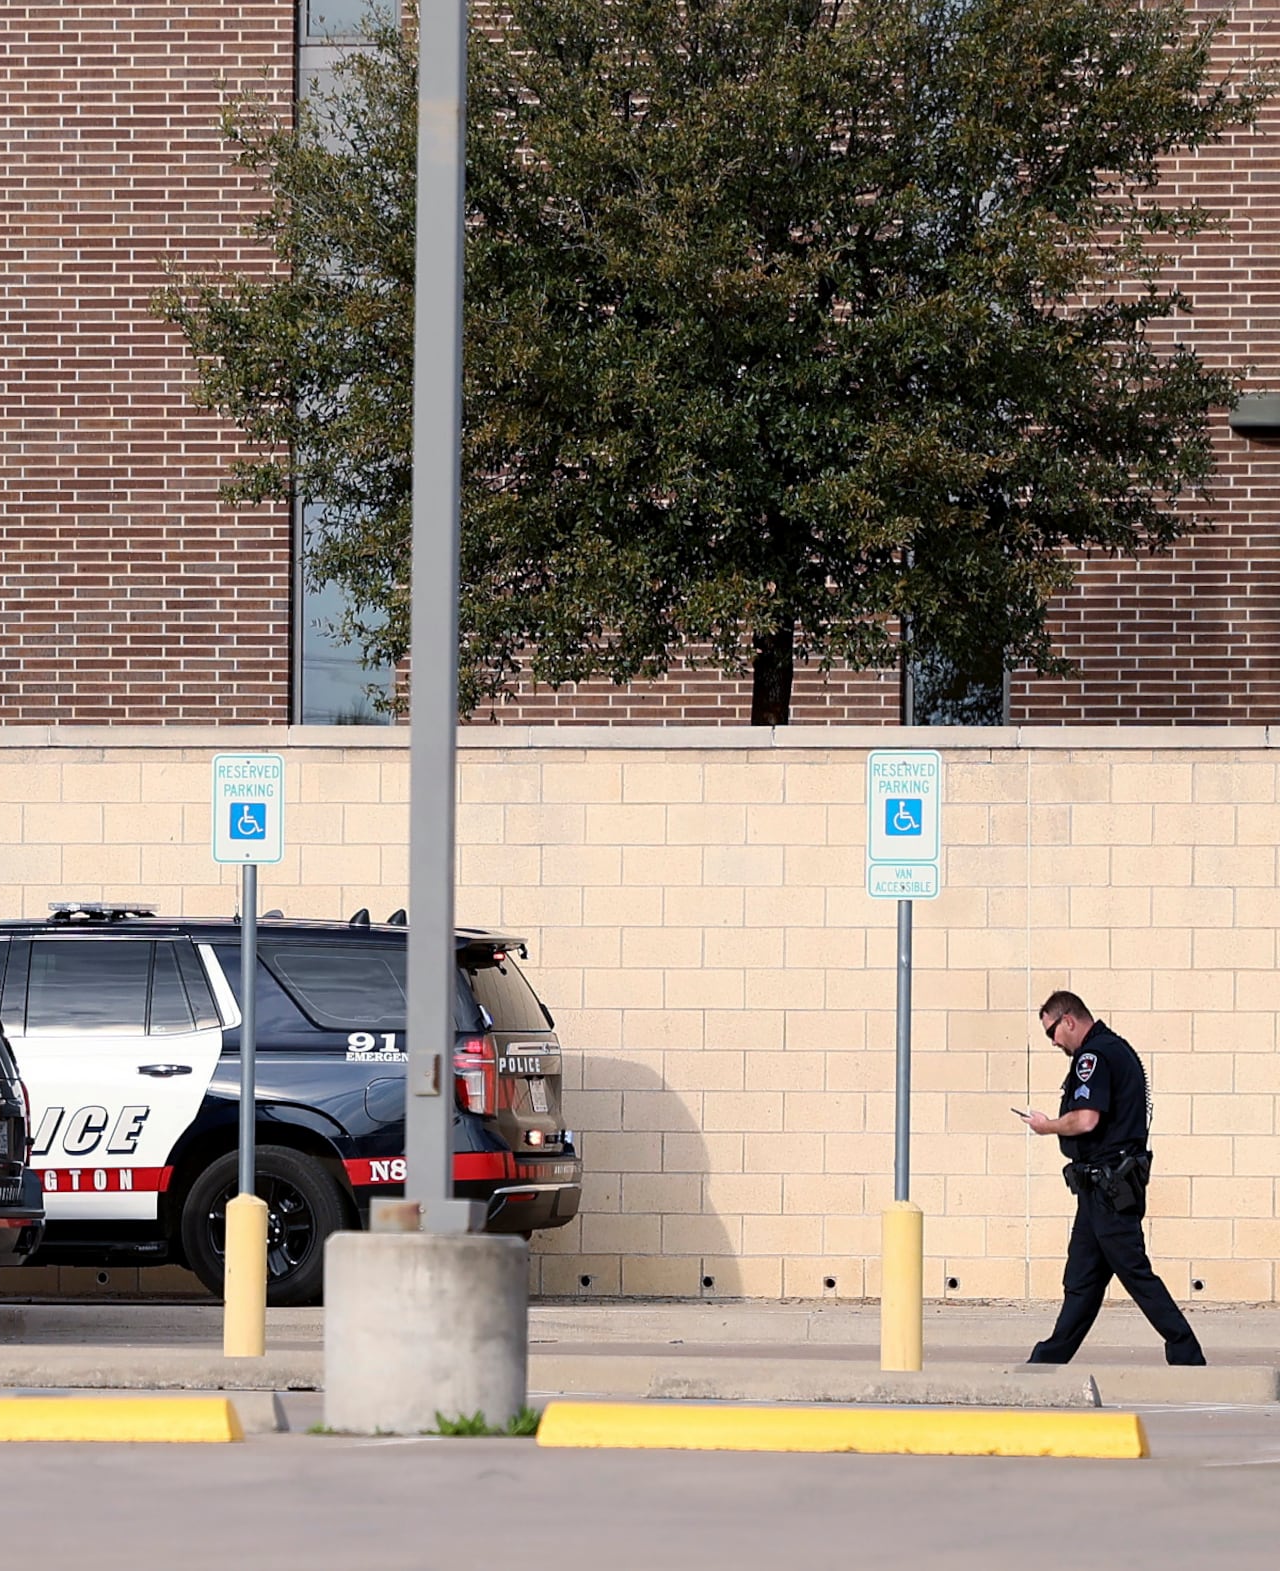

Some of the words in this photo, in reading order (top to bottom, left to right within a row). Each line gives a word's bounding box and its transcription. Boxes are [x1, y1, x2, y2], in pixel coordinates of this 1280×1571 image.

[218, 765, 280, 779] RESERVED
[873, 763, 936, 777] RESERVED
[223, 784, 274, 797] PARKING
[878, 780, 930, 794] PARKING
[894, 868, 913, 879] VAN
[875, 881, 932, 893] ACCESSIBLE
[347, 1032, 400, 1053] 91
[346, 1052, 409, 1062] EMERGEN
[498, 1057, 541, 1073] POLICE
[30, 1105, 151, 1156] ICE
